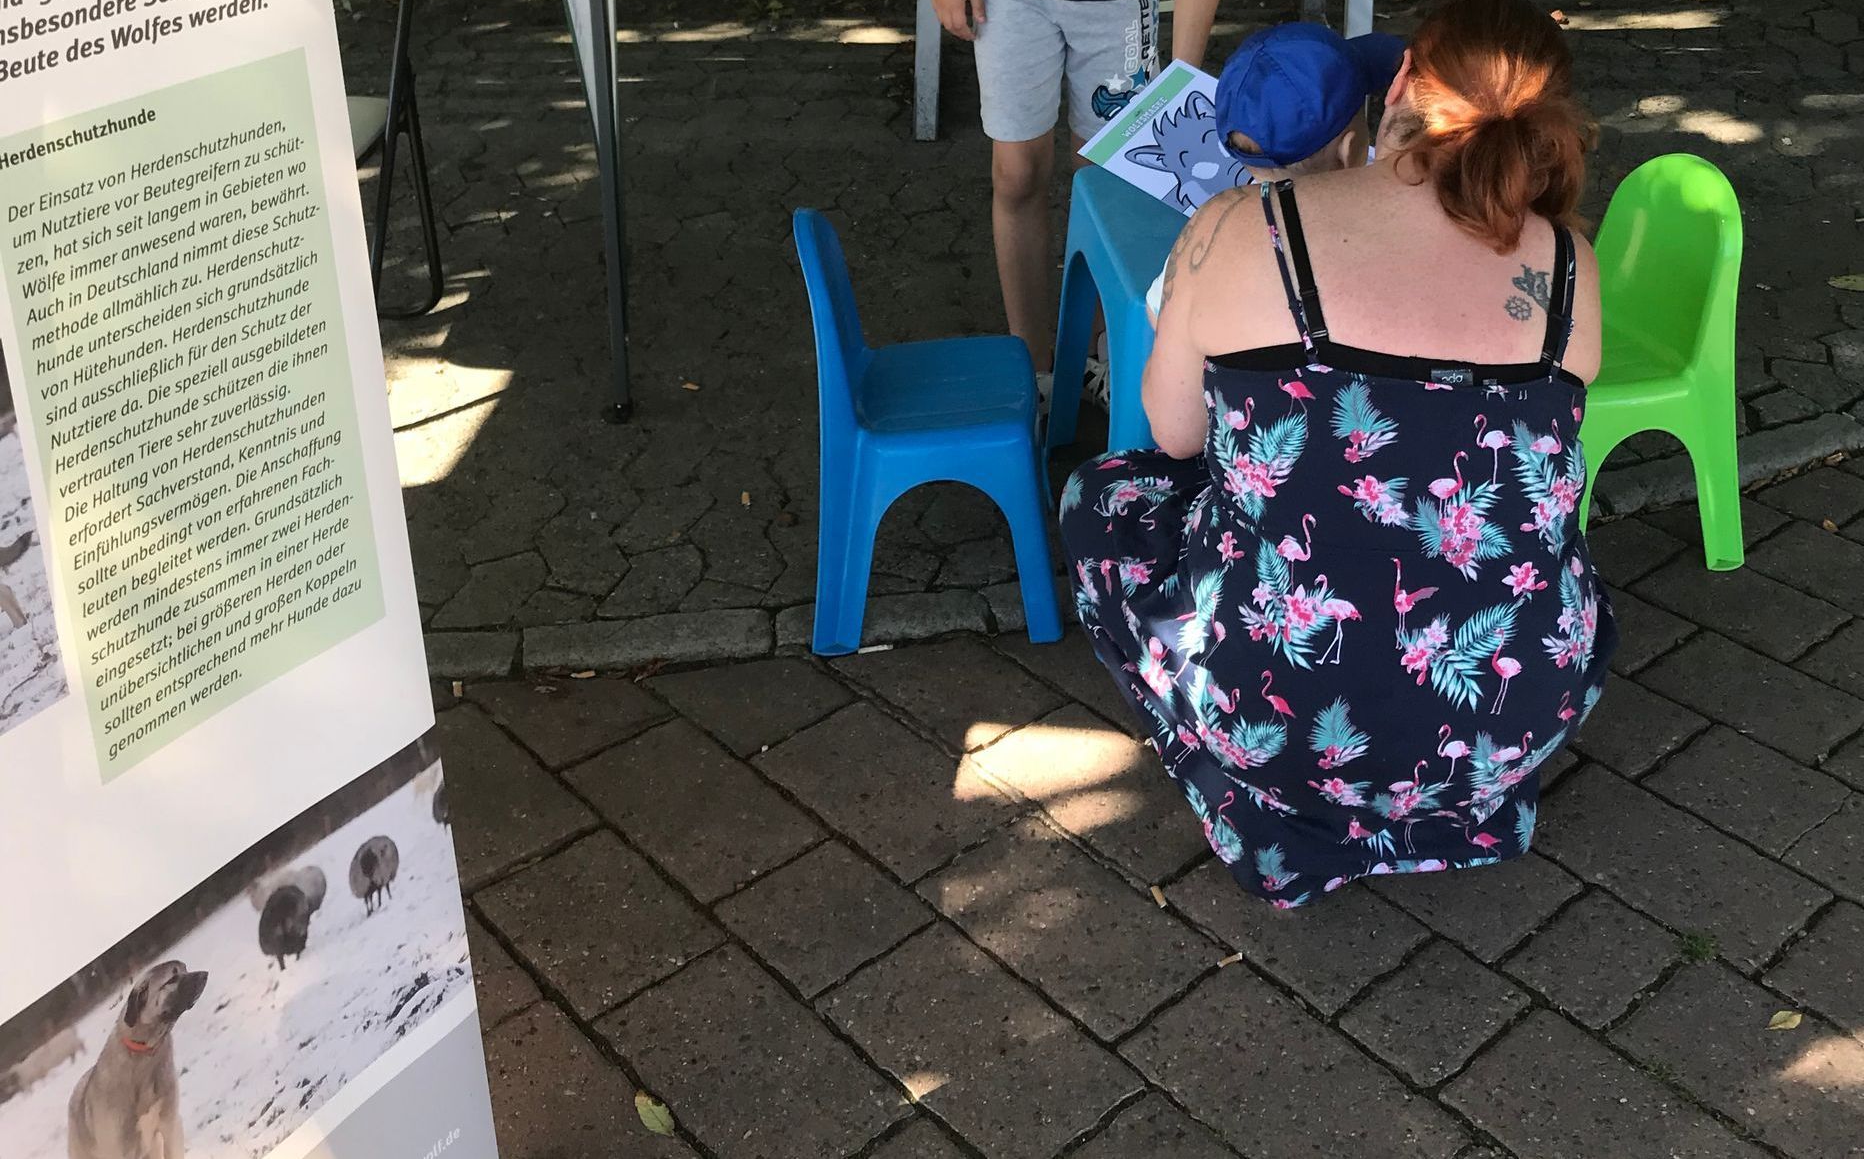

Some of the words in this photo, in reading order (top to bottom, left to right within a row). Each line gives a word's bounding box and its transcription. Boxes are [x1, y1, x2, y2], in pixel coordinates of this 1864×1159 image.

[0, 49, 60, 83] Beute
[65, 36, 105, 63] des
[110, 15, 183, 50] Wolfes
[0, 108, 157, 171] Herdenschutzhunde
[8, 201, 36, 224] Der
[39, 181, 95, 212] Einsatz
[97, 171, 126, 191] von
[130, 120, 286, 181] Herdenschutzhunden,
[13, 229, 37, 249] um
[41, 202, 111, 238] Nutztiere
[113, 192, 140, 212] vor
[143, 158, 241, 202] Beutegreifern
[243, 152, 261, 168] zu
[263, 136, 305, 162] schüt-
[16, 254, 49, 275] zen,
[53, 238, 79, 261] hat
[81, 225, 112, 250] sich
[115, 214, 144, 238] seit
[147, 196, 201, 227] langem
[205, 190, 218, 206] in
[222, 168, 284, 200] Gebieten
[287, 160, 307, 178] wo
[21, 270, 66, 300] Wölfe
[69, 252, 119, 282] immer
[121, 220, 196, 262] anwesend
[199, 208, 247, 233] waren,
[251, 182, 310, 215] bewährt.
[26, 296, 65, 326] Auch
[68, 292, 82, 309] in
[87, 251, 179, 302] Deutschland
[183, 235, 229, 265] nimmt
[231, 222, 269, 247] diese
[272, 204, 321, 232] Schutz-
[31, 311, 99, 352] methode
[102, 278, 178, 321] allmählich
[181, 273, 203, 291] zu.
[206, 235, 305, 281] Herdenschutz-
[36, 344, 84, 376] hunde
[88, 301, 192, 354] unterscheiden
[195, 286, 224, 311] sich
[227, 250, 318, 302] grundsätzlich
[40, 378, 69, 401] von
[73, 338, 168, 387] Hütehunden.
[172, 278, 310, 345] Herdenschutzhunde
[45, 396, 78, 426] sind
[81, 352, 184, 410] ausschließlich
[187, 344, 209, 368] für
[210, 332, 237, 354] den
[241, 312, 287, 342] Schutz
[289, 302, 313, 321] der
[51, 409, 117, 451] Nutztiere
[120, 398, 143, 417] da.
[147, 384, 171, 406] Die
[174, 356, 228, 394] speziell
[231, 320, 327, 370] ausgebildeten
[55, 397, 199, 475] Herdenschutzhunde
[202, 370, 264, 407] schützen
[267, 358, 289, 378] die
[292, 343, 328, 368] ihnen
[59, 452, 135, 498] vertrauten
[137, 434, 173, 460] Tiere
[176, 418, 209, 443] sehr
[210, 384, 291, 428] zuverlässig.
[64, 501, 89, 523] Die
[92, 470, 149, 509] Haltung
[151, 457, 179, 479] von
[182, 391, 326, 465] Herdenschutzhunden
[68, 502, 133, 547] erfordert
[135, 453, 235, 513] Sachverstand,
[238, 426, 297, 464] Kenntnis
[300, 410, 325, 436] und
[73, 483, 232, 571] Einfühlungsvermögen.
[235, 468, 258, 489] Die
[260, 430, 342, 478] Anschaffung
[77, 564, 118, 596] sollte
[121, 521, 193, 571] unbedingt
[195, 510, 222, 532] von
[225, 473, 298, 517] erfahrenen
[301, 456, 335, 482] Fach-
[82, 584, 127, 619] leuten
[131, 546, 193, 591] begleitet
[195, 522, 251, 556] werden.
[254, 473, 343, 527] Grundsätzlich
[86, 602, 139, 642] werden
[143, 558, 223, 610] mindestens
[225, 534, 270, 566] immer
[271, 514, 301, 543] zwei
[304, 494, 354, 527] Herden-
[91, 604, 181, 666] schutzhunde
[183, 564, 257, 613] zusammen
[260, 556, 273, 572] in
[275, 537, 310, 564] einer
[312, 517, 349, 546] Herde
[95, 634, 173, 688] eingesetzt;
[176, 615, 198, 641] bei
[201, 585, 262, 631] größeren
[265, 559, 313, 592] Herden
[315, 541, 346, 566] oder
[100, 630, 222, 712] unübersichtlichen
[225, 610, 251, 638] und
[254, 587, 302, 625] großen
[305, 558, 357, 596] Koppeln
[104, 696, 152, 735] sollten
[155, 636, 247, 703] entsprechend
[250, 619, 285, 648] mehr
[287, 596, 329, 628] Hunde
[331, 578, 362, 603] dazu
[109, 700, 187, 762] genommen
[189, 668, 243, 706] werden.
